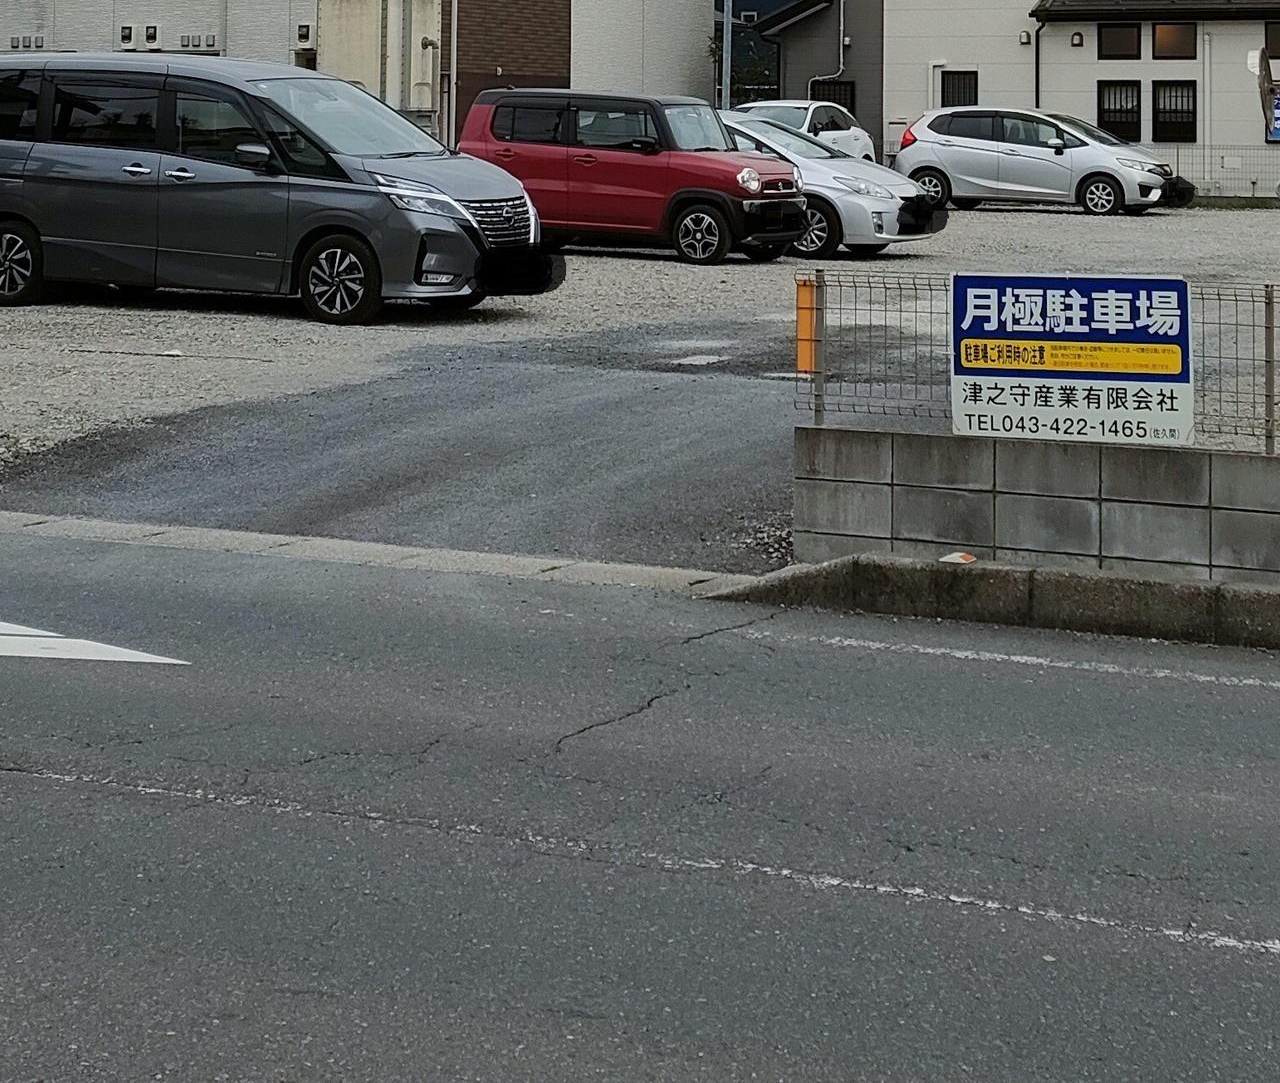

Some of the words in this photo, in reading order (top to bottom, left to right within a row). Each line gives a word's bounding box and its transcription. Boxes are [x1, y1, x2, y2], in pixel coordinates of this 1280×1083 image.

[960, 287, 1182, 336] 月極駐車場
[964, 343, 1047, 365] 駐車場ご利用時の注意
[962, 381, 1180, 412] 津之守産業有限会社
